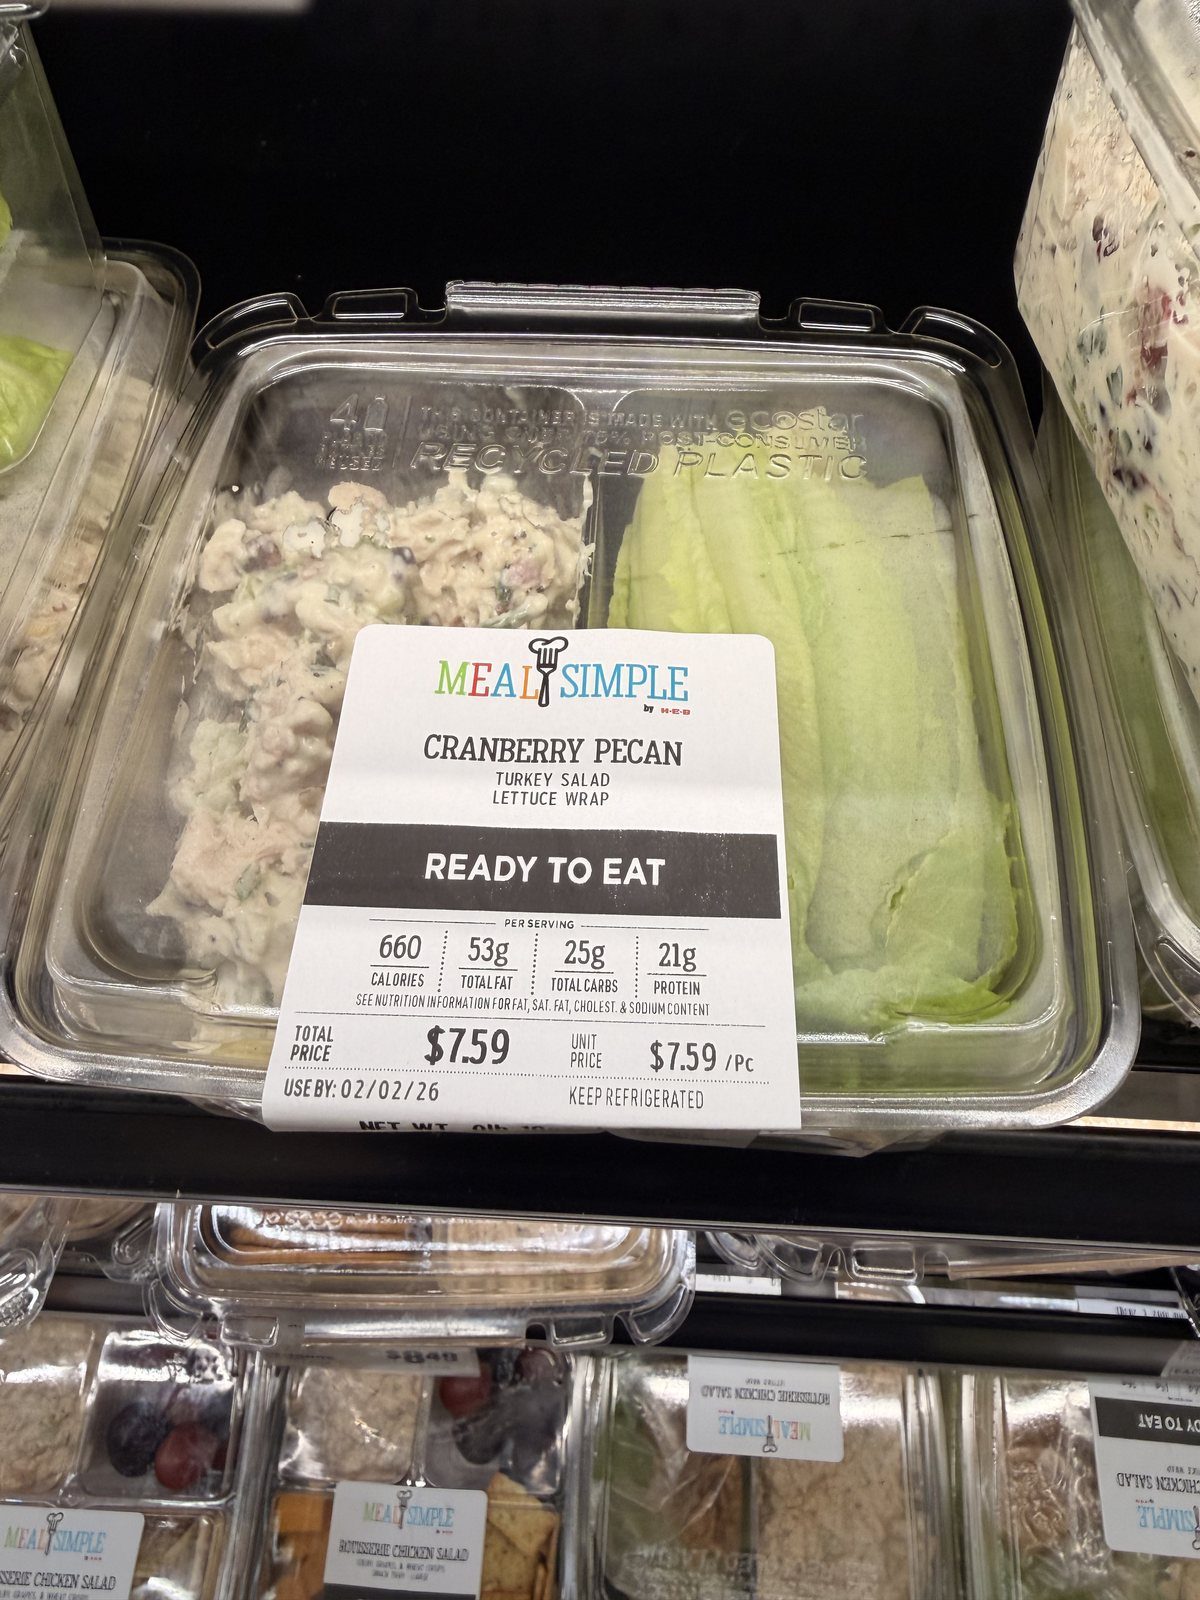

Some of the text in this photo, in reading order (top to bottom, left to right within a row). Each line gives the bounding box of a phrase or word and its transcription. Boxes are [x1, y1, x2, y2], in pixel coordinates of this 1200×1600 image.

[724, 406, 865, 437] ecostar
[410, 441, 868, 481] RECYCLED PLASTIC
[434, 660, 689, 702] MEAL SIMPLE
[643, 704, 654, 714] by
[424, 733, 683, 767] CRANBERRY PECAN
[496, 771, 611, 788] TURKEY SALAD
[492, 790, 610, 807] LETTUCE WRAP
[424, 852, 666, 886] READY TO EAT
[504, 918, 575, 930] PER SERVING
[379, 934, 422, 960] 660
[468, 936, 510, 967] 53g
[564, 939, 606, 970] 25g
[658, 942, 697, 972] 21g
[371, 972, 425, 988] CALORIES
[461, 975, 514, 991] TOTAL FAT
[551, 977, 619, 993] TOTAL CARBS
[653, 980, 701, 996] PROTEIN
[355, 993, 711, 1017] SEE NUTRITION INFORMATION FOR FAT, SAT. FAT, CHOLEST. & SODIUM CONTENT
[294, 1025, 334, 1043] TOTAL
[571, 1033, 597, 1051] UNIT
[290, 1044, 331, 1063] PRICE
[425, 1026, 511, 1066] $7.59
[650, 1040, 717, 1073] $7.59
[570, 1051, 603, 1069] PRICE
[283, 1080, 440, 1102] USE BY: 02/02/26
[569, 1087, 704, 1109] KEEP REFRIGERATED
[718, 1415, 811, 1441] MEAL SIMPLE
[1137, 1413, 1162, 1429] EAT
[1165, 1417, 1183, 1432] TO
[1116, 1473, 1153, 1490] SALAD
[363, 1502, 455, 1528] MEAL SIMPLE
[1136, 1505, 1194, 1532] SIMPLE
[4, 1526, 106, 1554] MEAL SIMPLE
[436, 1547, 470, 1562] SALAD
[34, 1572, 80, 1589] CHICKEN
[81, 1574, 116, 1590] SALAD
